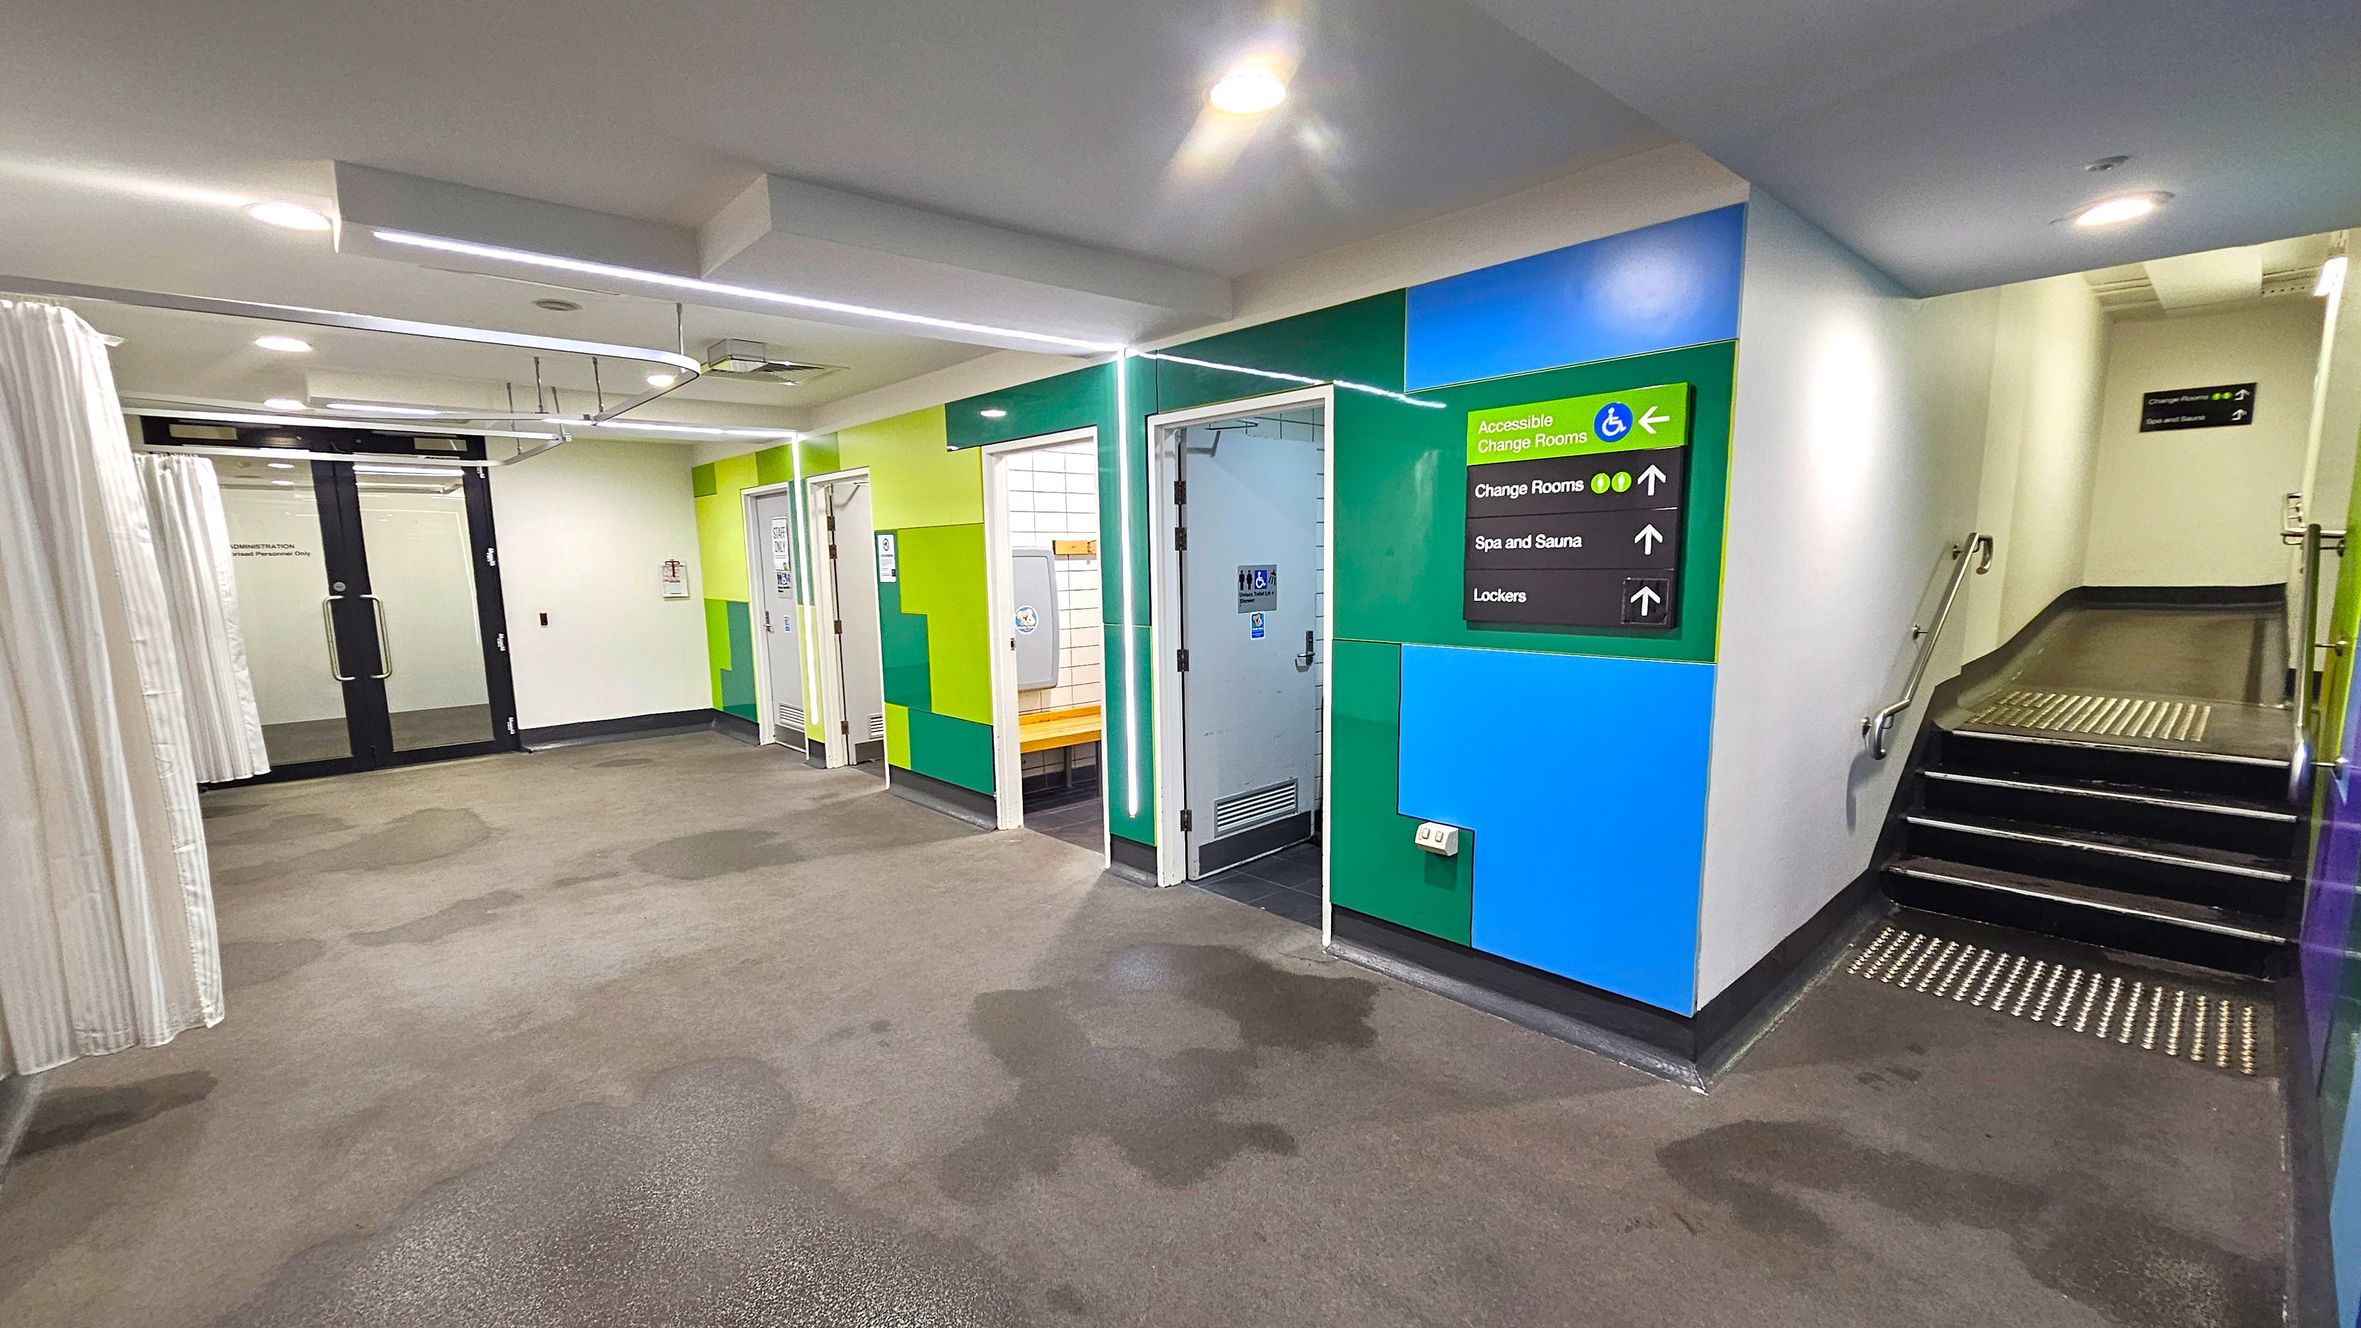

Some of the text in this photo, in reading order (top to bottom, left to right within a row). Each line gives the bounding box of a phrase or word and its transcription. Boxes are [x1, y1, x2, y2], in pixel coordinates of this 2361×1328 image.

[1478, 414, 1553, 434] Accessible
[1477, 432, 1588, 453] Change Rooms
[1475, 480, 1585, 499] Change Rooms
[772, 526, 786, 539] STAFF
[774, 541, 786, 553] ONLY
[1475, 533, 1583, 552] Spa and Sauna
[1473, 588, 1527, 603] Lockers
